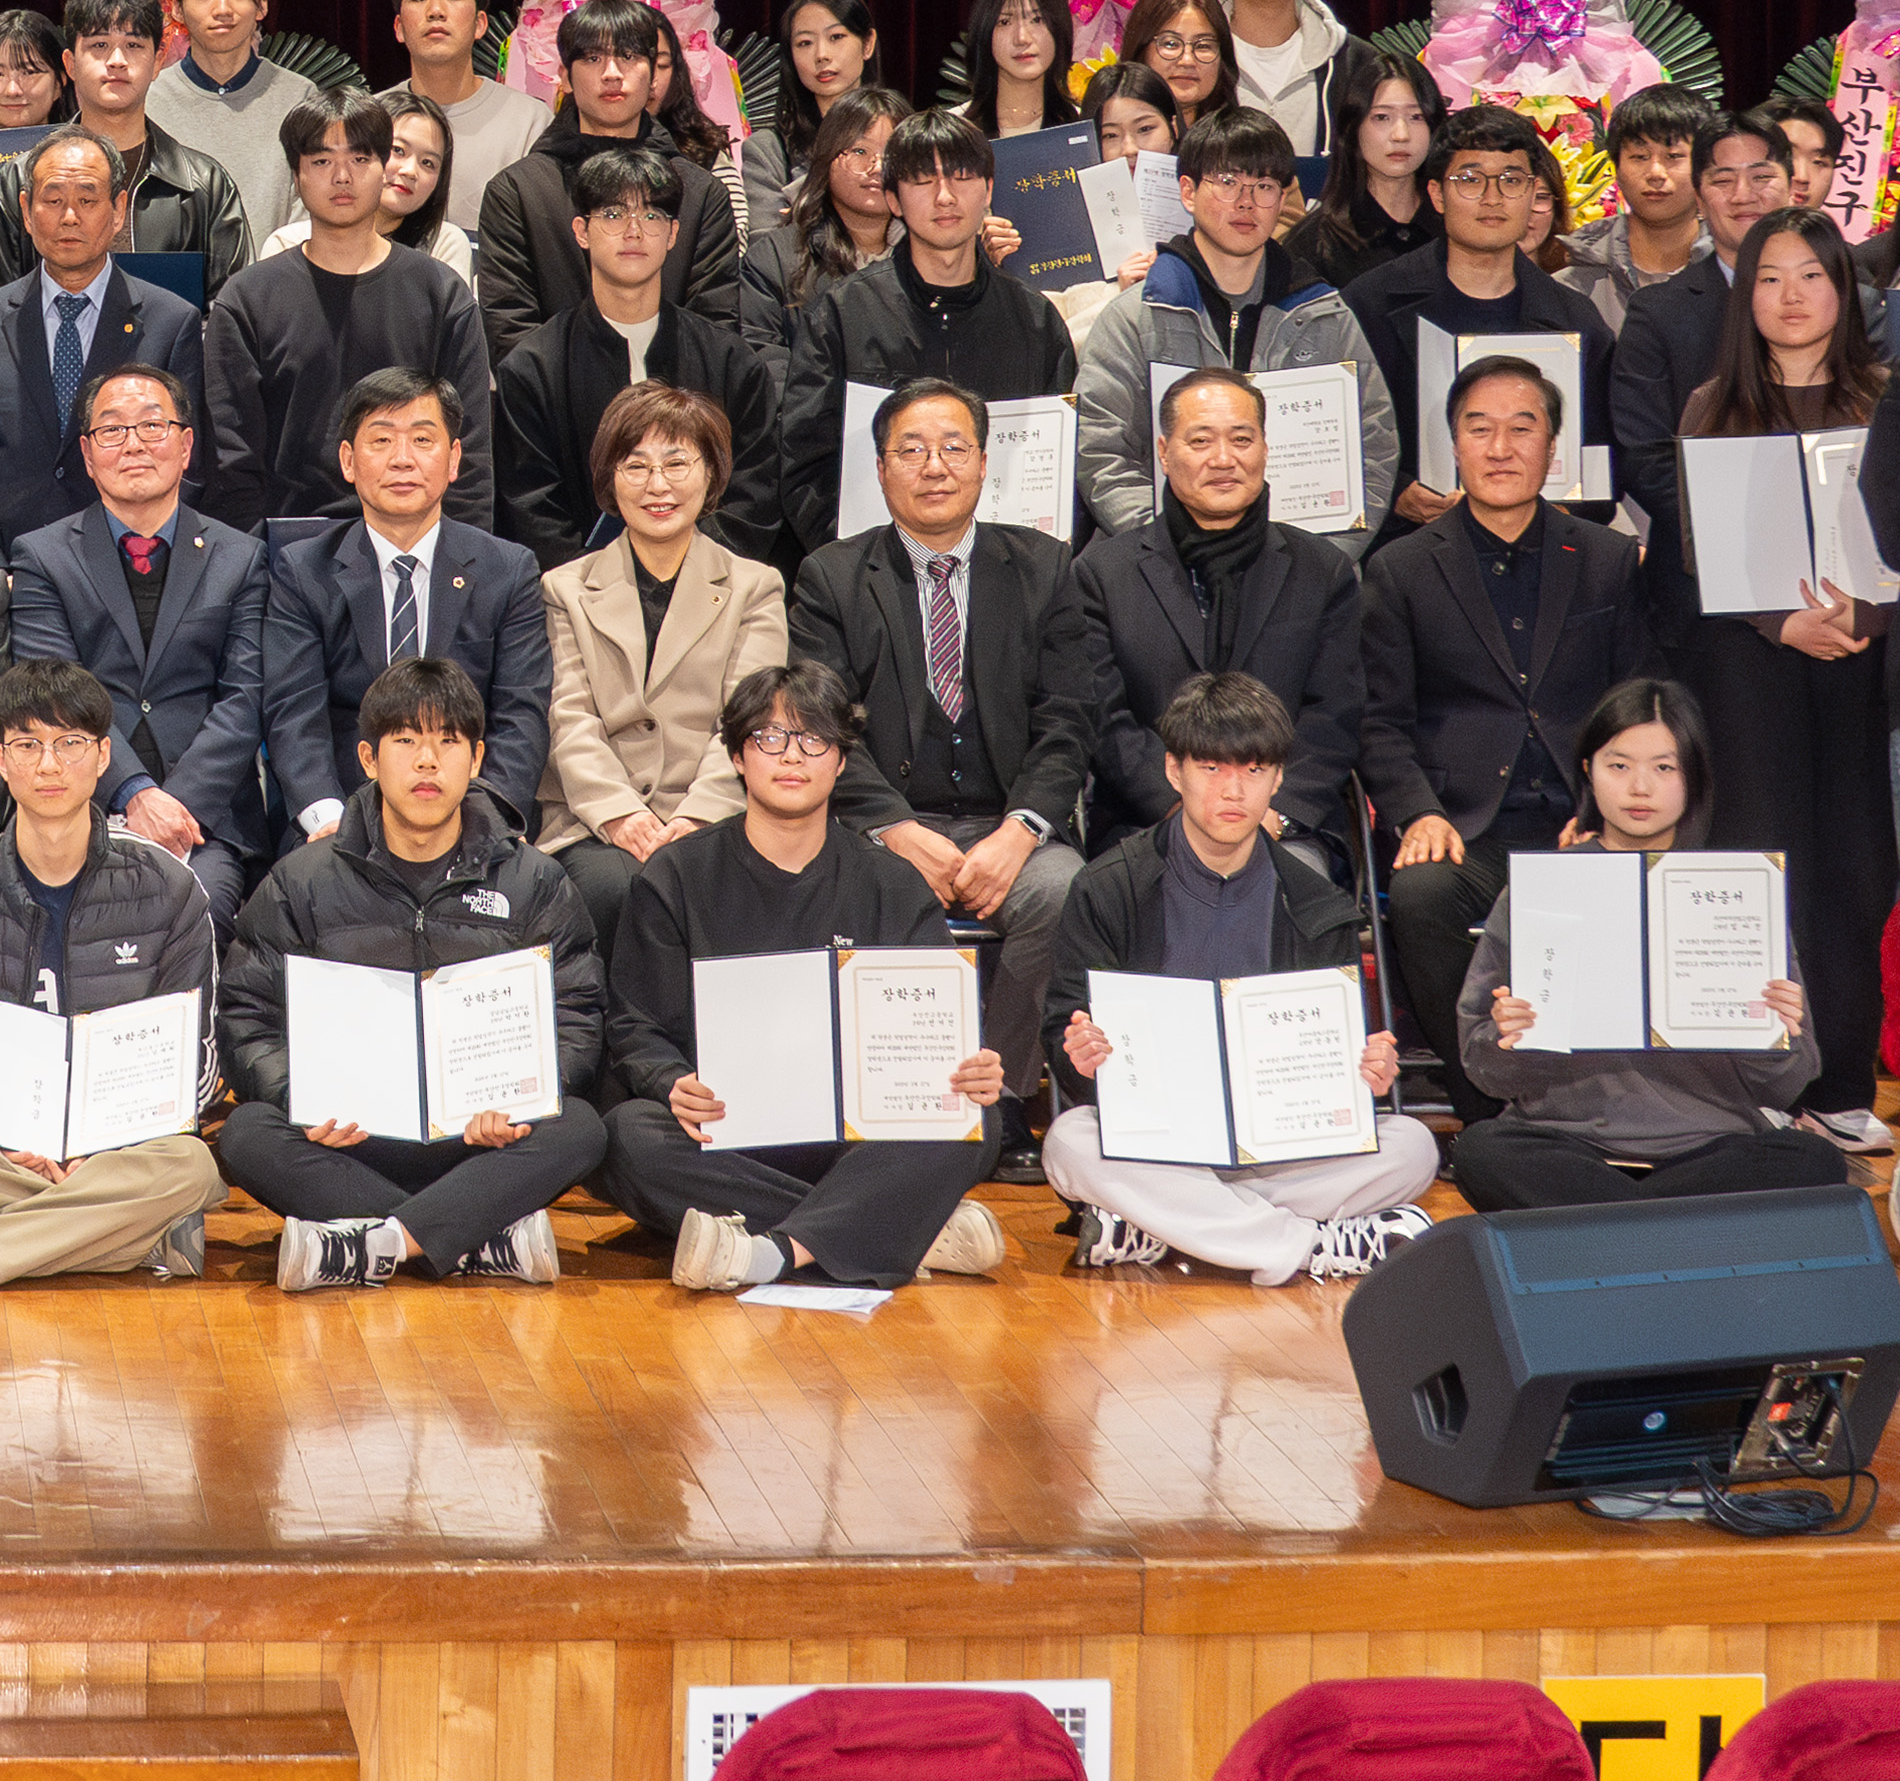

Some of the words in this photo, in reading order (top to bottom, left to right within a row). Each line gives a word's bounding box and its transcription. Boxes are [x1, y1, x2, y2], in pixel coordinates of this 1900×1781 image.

[477, 888, 496, 900] THE
[462, 894, 496, 908] NORTH
[470, 903, 496, 916] FACE
[832, 934, 854, 947] New
[462, 986, 512, 1007] 장학증서
[881, 987, 937, 1002] 장학증서
